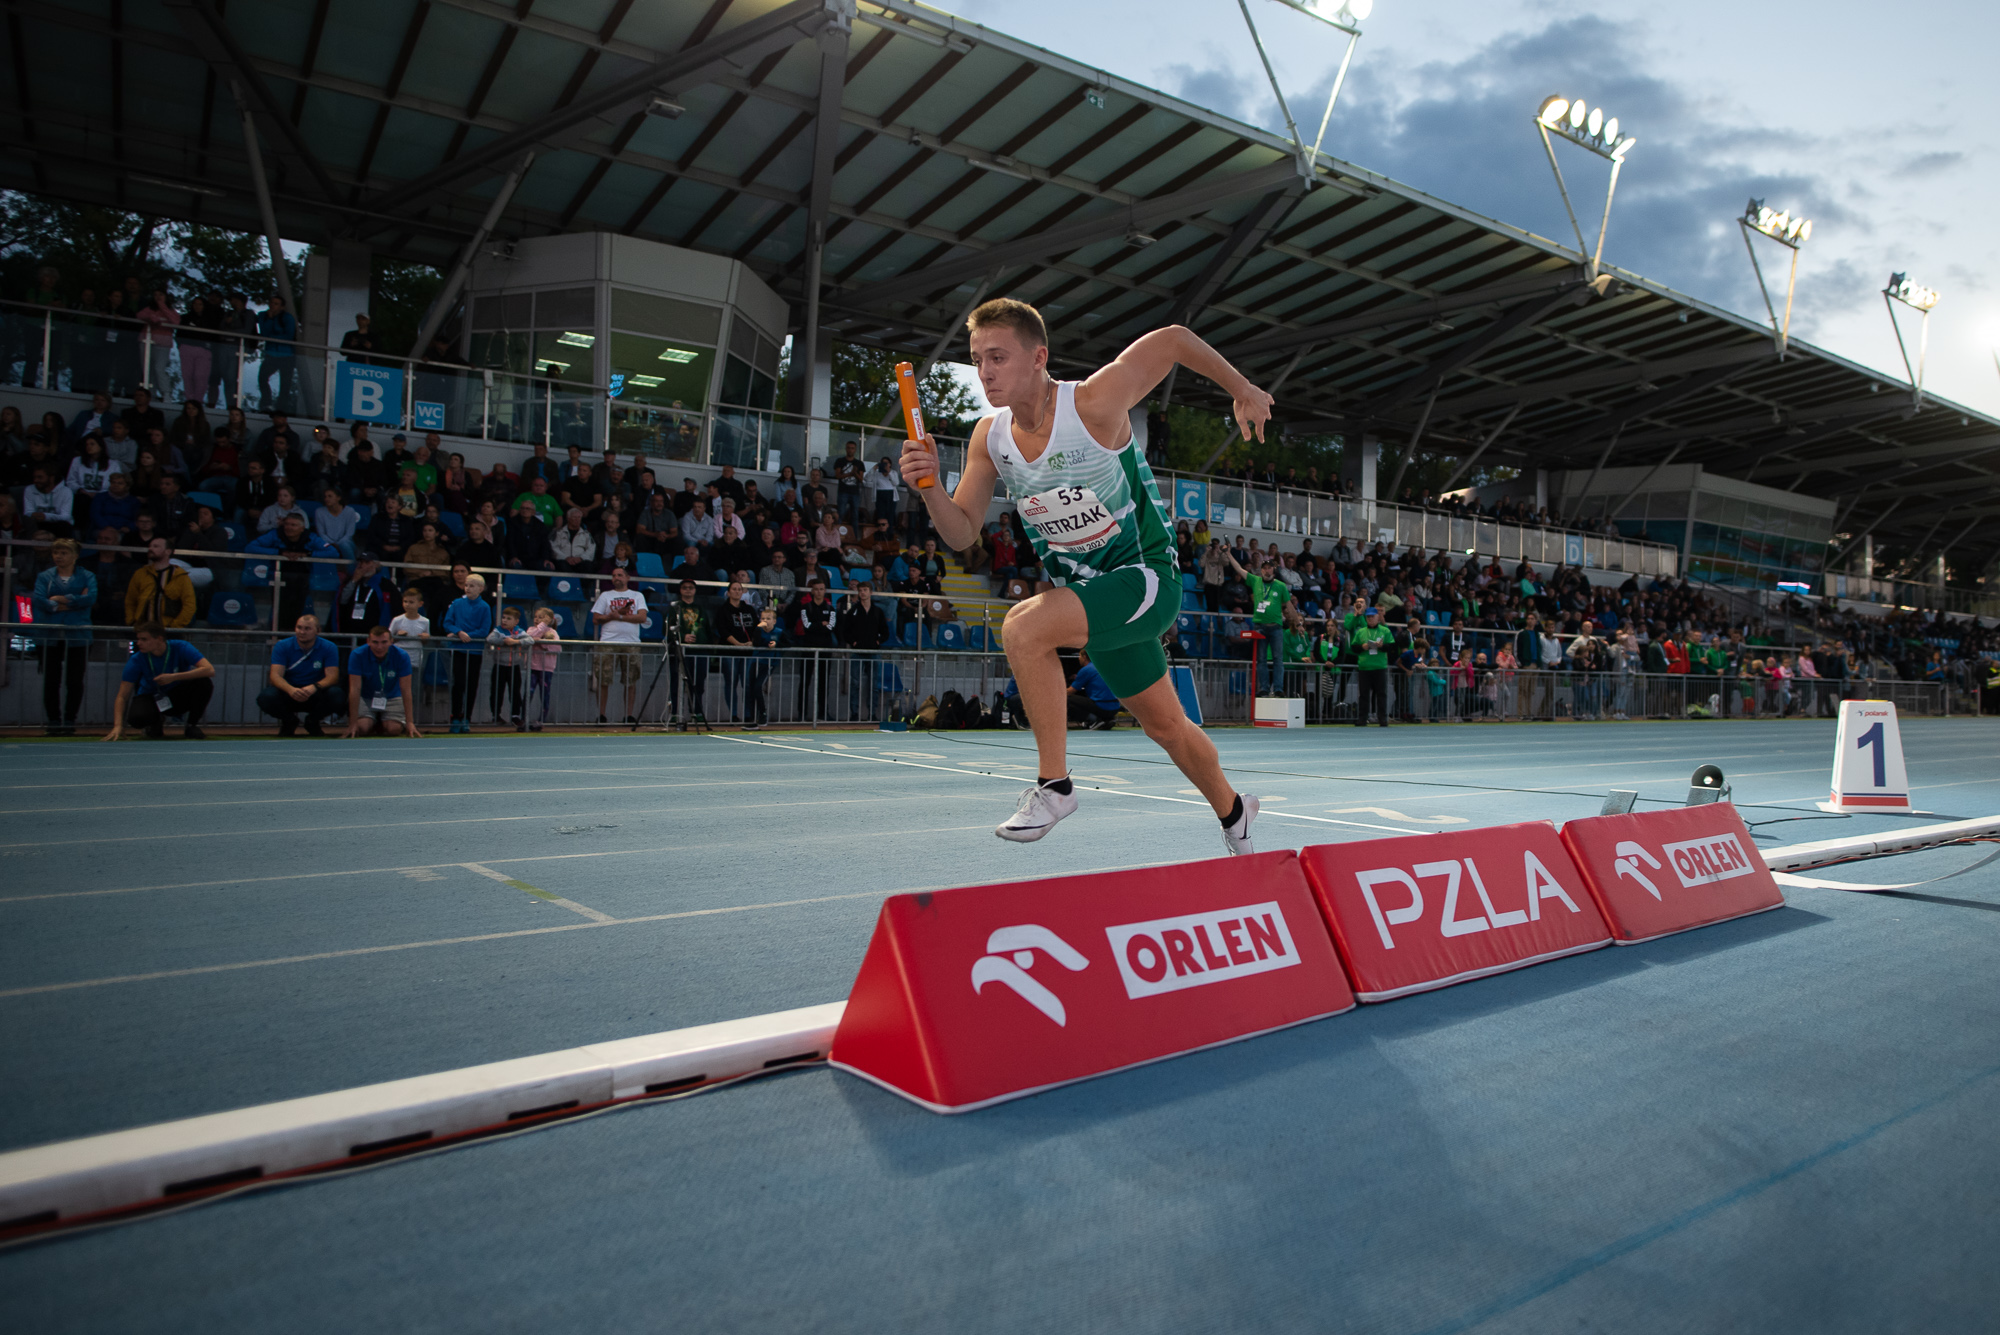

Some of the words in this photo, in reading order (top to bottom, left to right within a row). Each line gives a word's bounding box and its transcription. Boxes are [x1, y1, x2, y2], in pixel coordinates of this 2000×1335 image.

[349, 366, 390, 380] SEKTOR
[352, 379, 384, 417] B
[417, 405, 442, 419] WC
[1058, 485, 1083, 506] 53
[1183, 490, 1200, 516] C
[1025, 507, 1047, 516] ORLEN
[1033, 505, 1107, 536] PIETRZAK
[1212, 506, 1225, 515] WC
[1086, 538, 1106, 550] 2021
[1569, 543, 1580, 563] D
[1857, 722, 1886, 787] 1
[1673, 837, 1747, 879] ORLEN
[1354, 849, 1582, 950] PZLA
[1126, 913, 1288, 983] ORLEN
